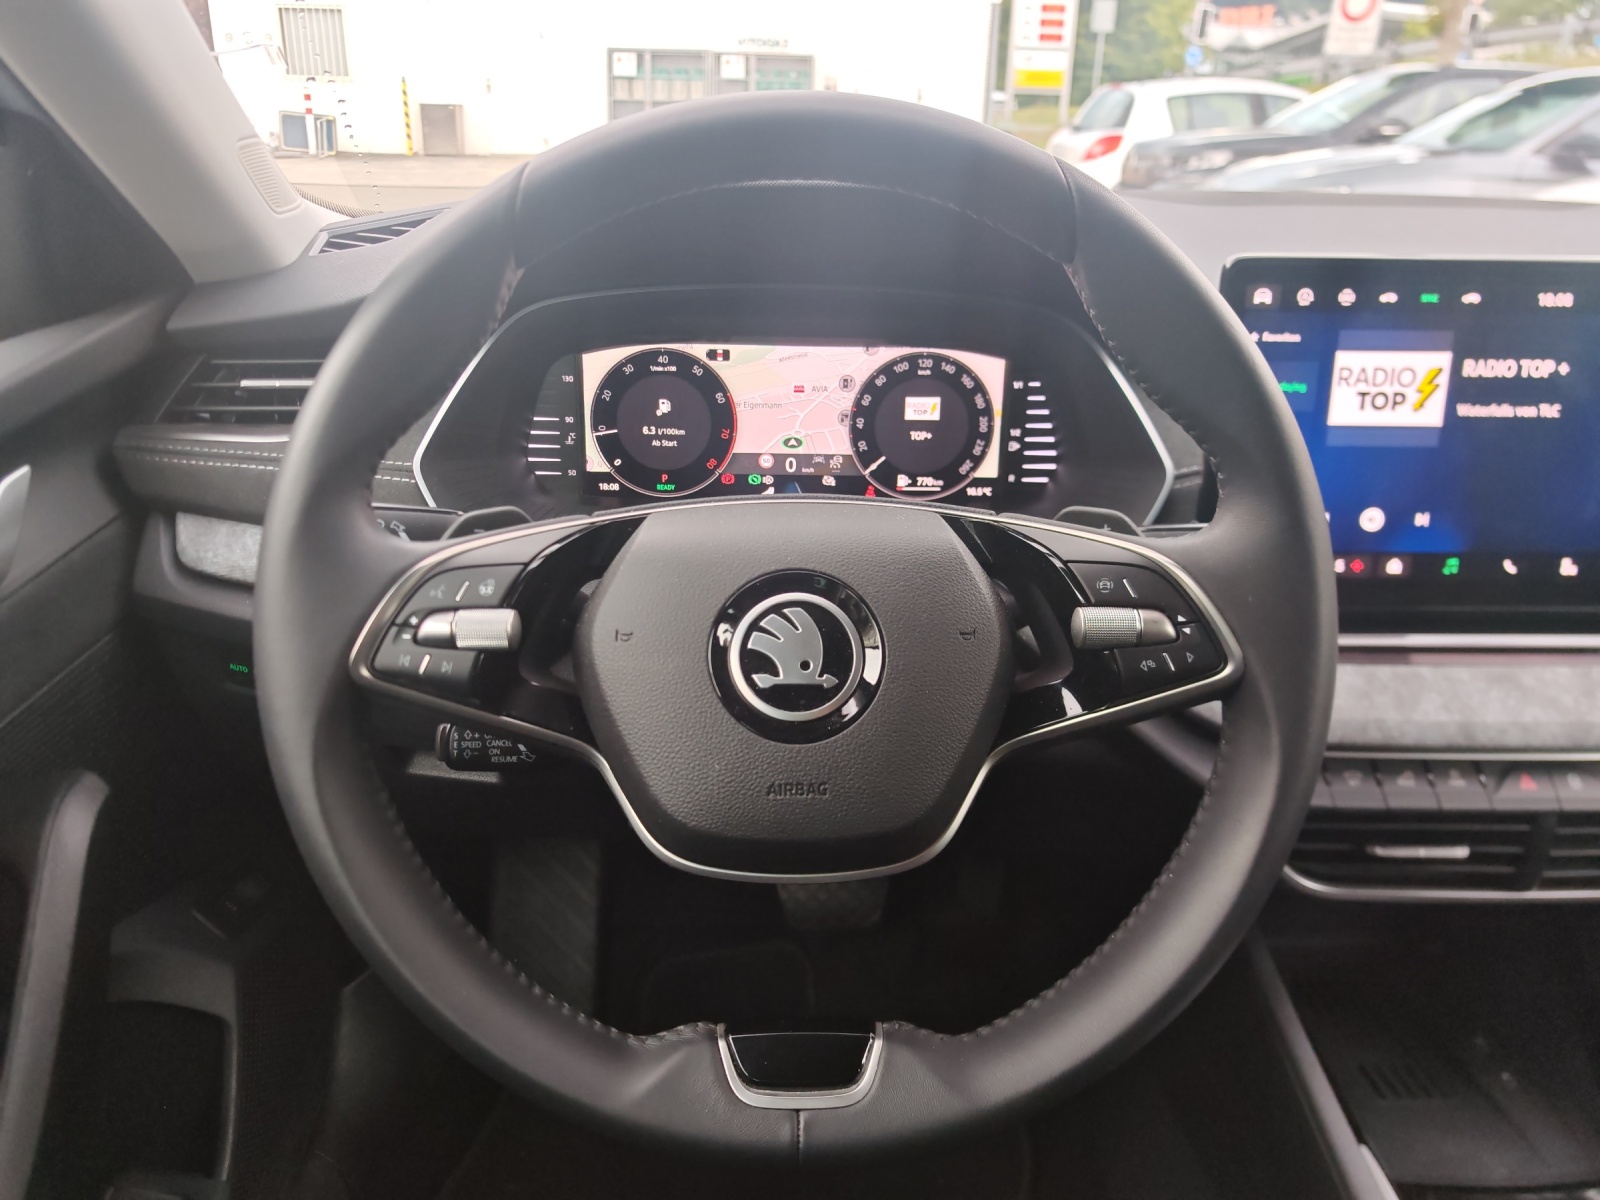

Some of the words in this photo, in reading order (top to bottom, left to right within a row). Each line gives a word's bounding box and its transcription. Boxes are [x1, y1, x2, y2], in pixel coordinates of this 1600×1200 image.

[658, 355, 668, 363] 40
[918, 359, 933, 367] 120
[623, 364, 634, 375] 30
[692, 365, 703, 376] 50
[893, 362, 909, 373] 100
[941, 362, 956, 374] 140
[1462, 359, 1518, 378] RADIO
[1520, 359, 1556, 378] TOP
[875, 375, 886, 386] 80
[961, 374, 974, 388] 160
[1337, 366, 1416, 388] RADIO
[602, 390, 612, 402] 20
[716, 393, 725, 403] 60
[861, 394, 872, 406] 60
[974, 393, 985, 409] 180
[1358, 391, 1406, 410] TOP
[856, 418, 864, 429] 40
[979, 416, 988, 432] 200
[643, 426, 656, 434] 6.3
[721, 429, 729, 439] 70
[858, 440, 867, 452] 20
[707, 458, 717, 469] 80
[785, 458, 796, 472] 0
[959, 459, 974, 475] 260
[662, 474, 668, 482] P
[230, 664, 248, 673] AUTO
[766, 782, 830, 797] AIRBAG
